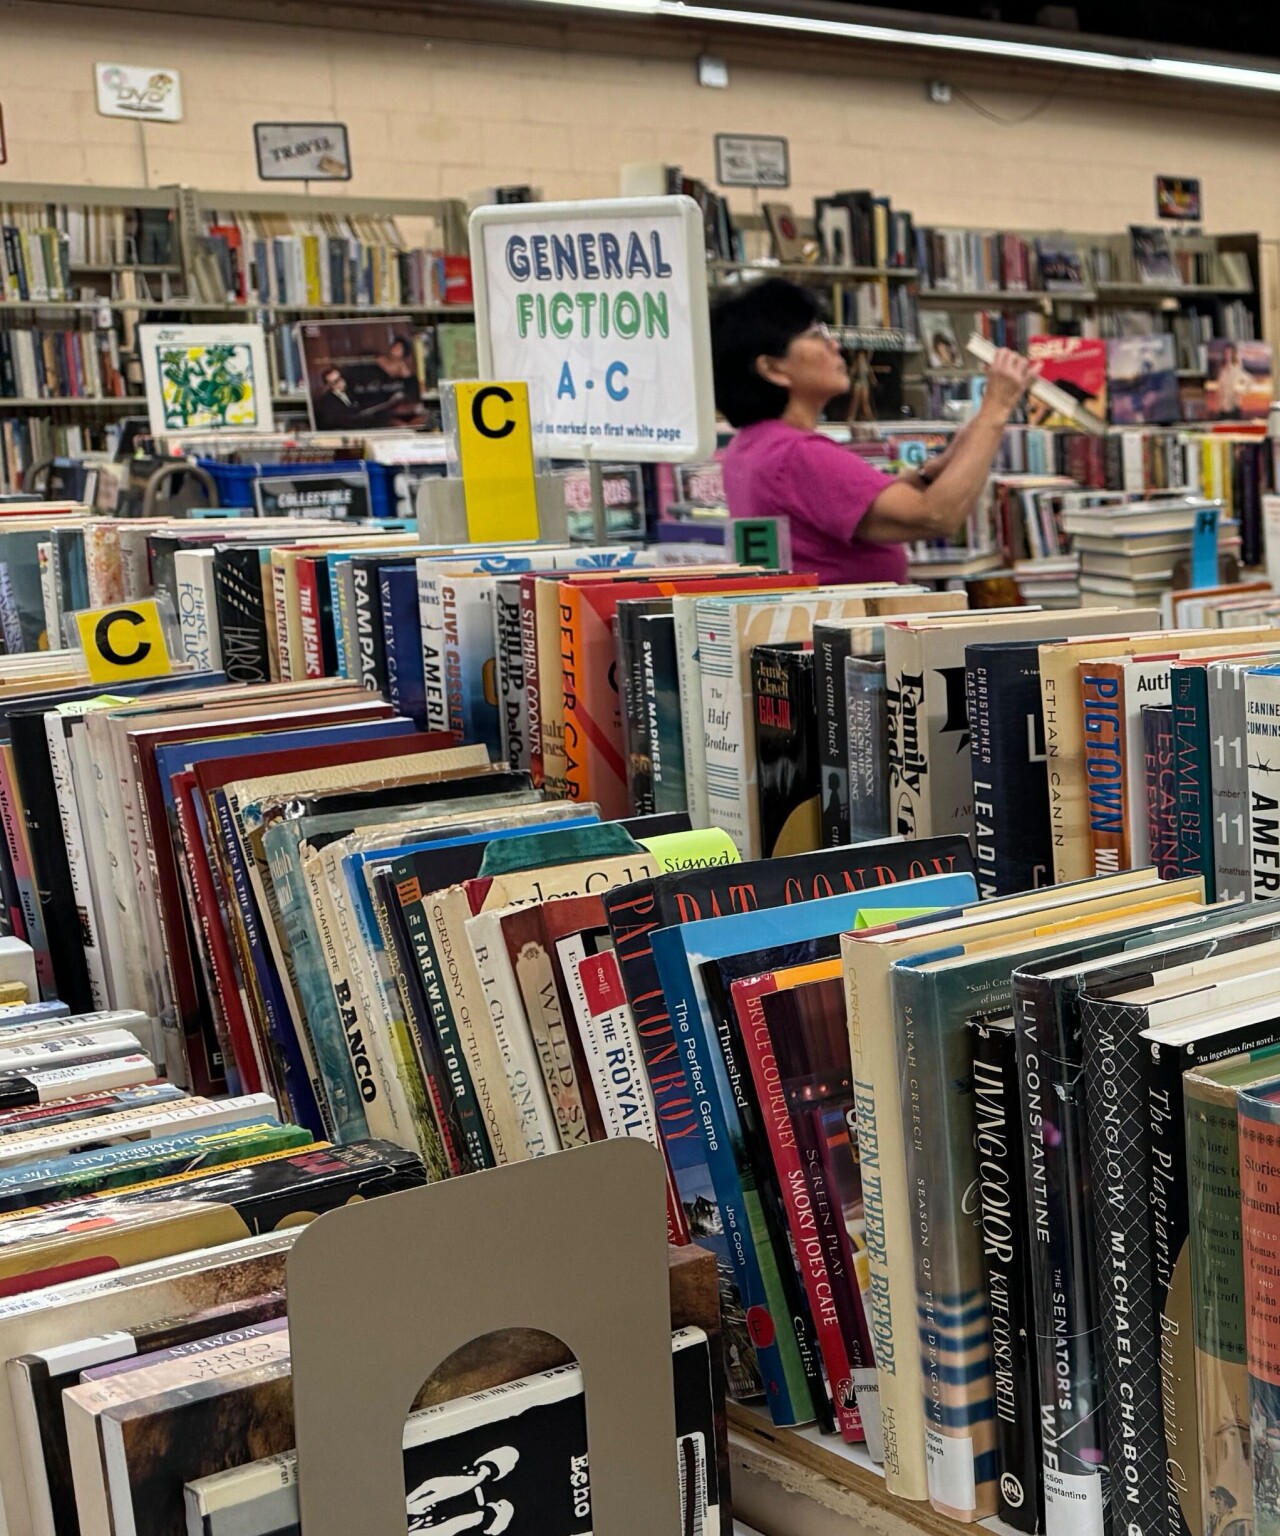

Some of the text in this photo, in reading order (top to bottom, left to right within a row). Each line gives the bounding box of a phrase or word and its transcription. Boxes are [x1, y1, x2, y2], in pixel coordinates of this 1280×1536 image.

[117, 86, 165, 103] DVD
[270, 136, 336, 162] TRAVEL
[506, 230, 672, 282] GENERAL
[516, 291, 670, 339] FICTION
[557, 361, 630, 401] A C
[471, 386, 517, 439] C
[556, 422, 587, 435] marked
[590, 425, 602, 436] on
[604, 422, 624, 437] first
[627, 424, 654, 438] white
[657, 427, 681, 441] page
[742, 525, 770, 563] E
[1200, 511, 1218, 534] H
[380, 580, 395, 650] WILEY
[442, 586, 460, 646] CLIVE
[480, 591, 492, 603] #1
[95, 610, 152, 666] C
[300, 587, 320, 676] THE MEANS
[353, 569, 378, 692] RAMPAG
[504, 601, 524, 690] PHILIP
[559, 604, 577, 708] PETER
[445, 650, 466, 741] CUSSLER
[521, 609, 541, 755] STEPHEN COONTS
[633, 661, 645, 720] THOMAS
[711, 688, 723, 699] The
[757, 661, 789, 679] James
[757, 676, 789, 698] Clavell
[823, 642, 840, 756] you came back
[643, 640, 662, 783] SWEET MADNESS
[707, 708, 732, 733] Half
[759, 696, 791, 731] GAI-JIN
[901, 669, 928, 798] Family
[967, 671, 979, 756] CASTELLANI
[976, 667, 991, 763] CHRISTOPHER
[1247, 701, 1280, 718] JEANINE
[704, 732, 740, 753] Brother
[1045, 679, 1064, 846] ETHAN CANIN
[1083, 675, 1124, 834] PIGTOWN
[1213, 735, 1243, 769] 11
[1216, 812, 1244, 846] 11
[219, 805, 257, 948] PICTURES THE DARK
[1218, 866, 1251, 877] Jonathan
[22, 889, 36, 930] Emily
[408, 914, 422, 926] The
[265, 999, 277, 1030] CROSS
[413, 931, 452, 1040] FAREWELL
[848, 967, 864, 1063] CARKEET
[334, 977, 377, 1103] BANCO
[433, 905, 509, 1165] CEREMONY OF THE INNOCENT
[539, 983, 575, 1089] WILD
[717, 1020, 749, 1109] Thrashed
[444, 1044, 466, 1099] TOUR
[600, 1014, 645, 1137] THE ROYAL
[675, 999, 719, 1152] The Perfect Game
[747, 997, 798, 1151] BRYCE COURTNEY
[904, 1006, 923, 1151] SARAH CREECH
[1021, 999, 1051, 1244] LIV CONSTANTINE
[1256, 1181, 1269, 1194] to
[726, 1205, 746, 1266] Joe Coon
[916, 1178, 935, 1325] SEASON OF THE
[1098, 1028, 1141, 1505] MOONGLOW MICHAEL CHABON
[1255, 1291, 1277, 1307] John
[168, 1326, 266, 1358] WOMEN
[193, 1341, 273, 1371] CARR
[1052, 1268, 1073, 1412] THE SENATOR'S
[886, 1406, 900, 1477] HARPER
